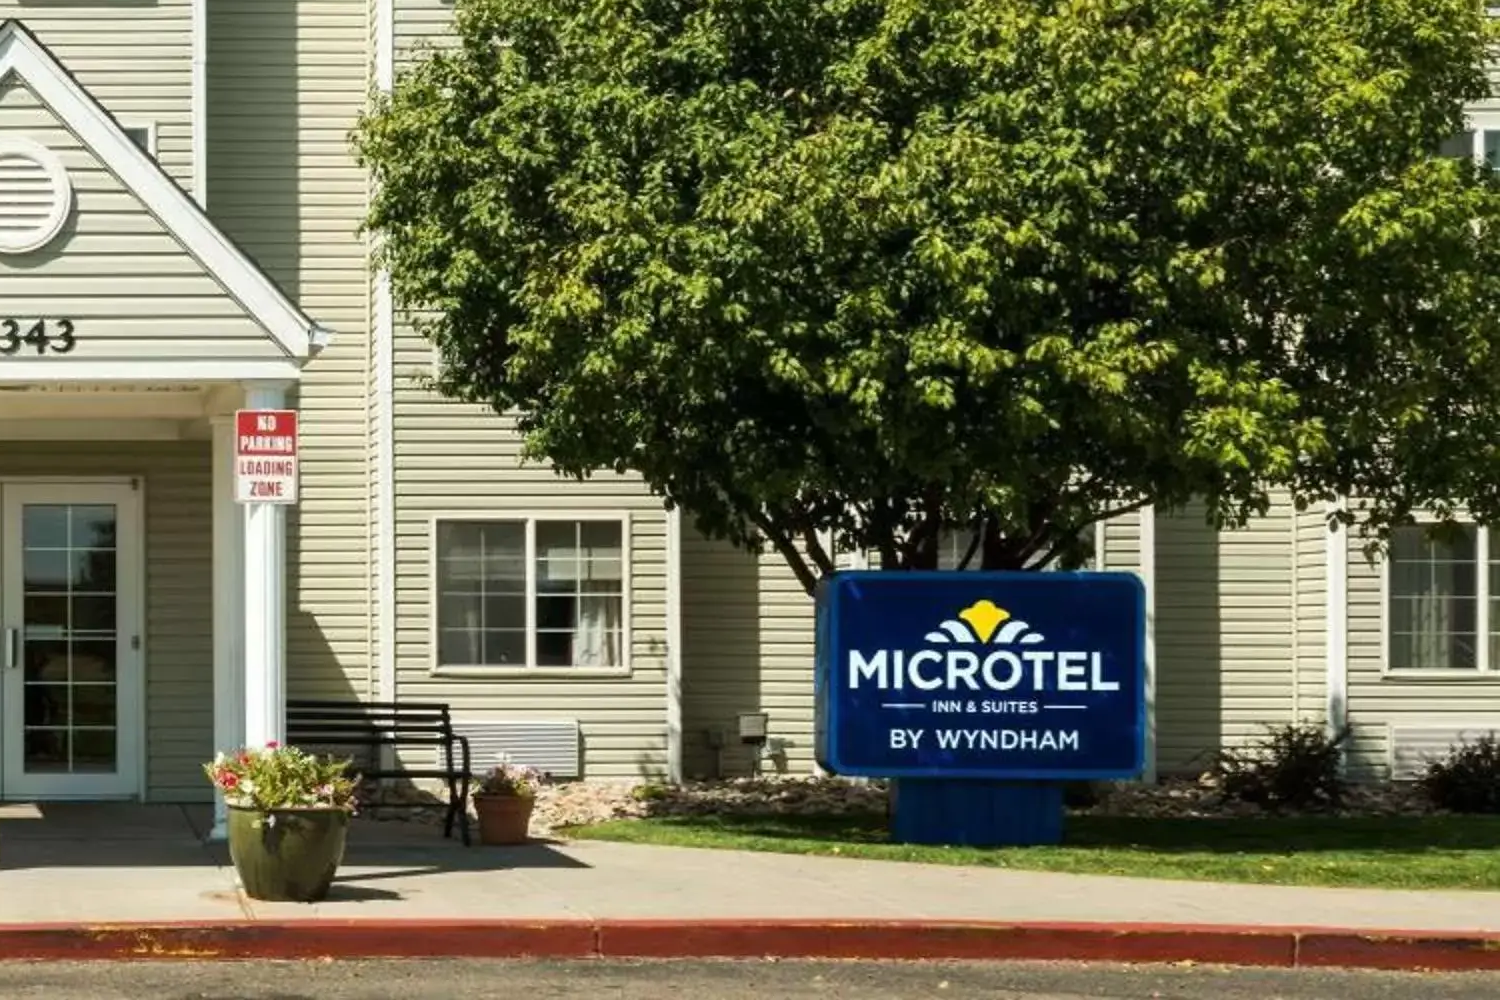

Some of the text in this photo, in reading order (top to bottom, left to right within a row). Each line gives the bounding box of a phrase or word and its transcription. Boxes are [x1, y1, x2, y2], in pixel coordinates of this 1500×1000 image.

[257, 415, 277, 432] NO
[240, 436, 293, 452] PARKING
[240, 461, 293, 476] LOADING
[250, 481, 283, 497] ZONE
[849, 649, 1120, 691] MICROTEL
[932, 699, 1038, 714] INN & SUITES
[889, 729, 1079, 750] BY WYNDHAM
